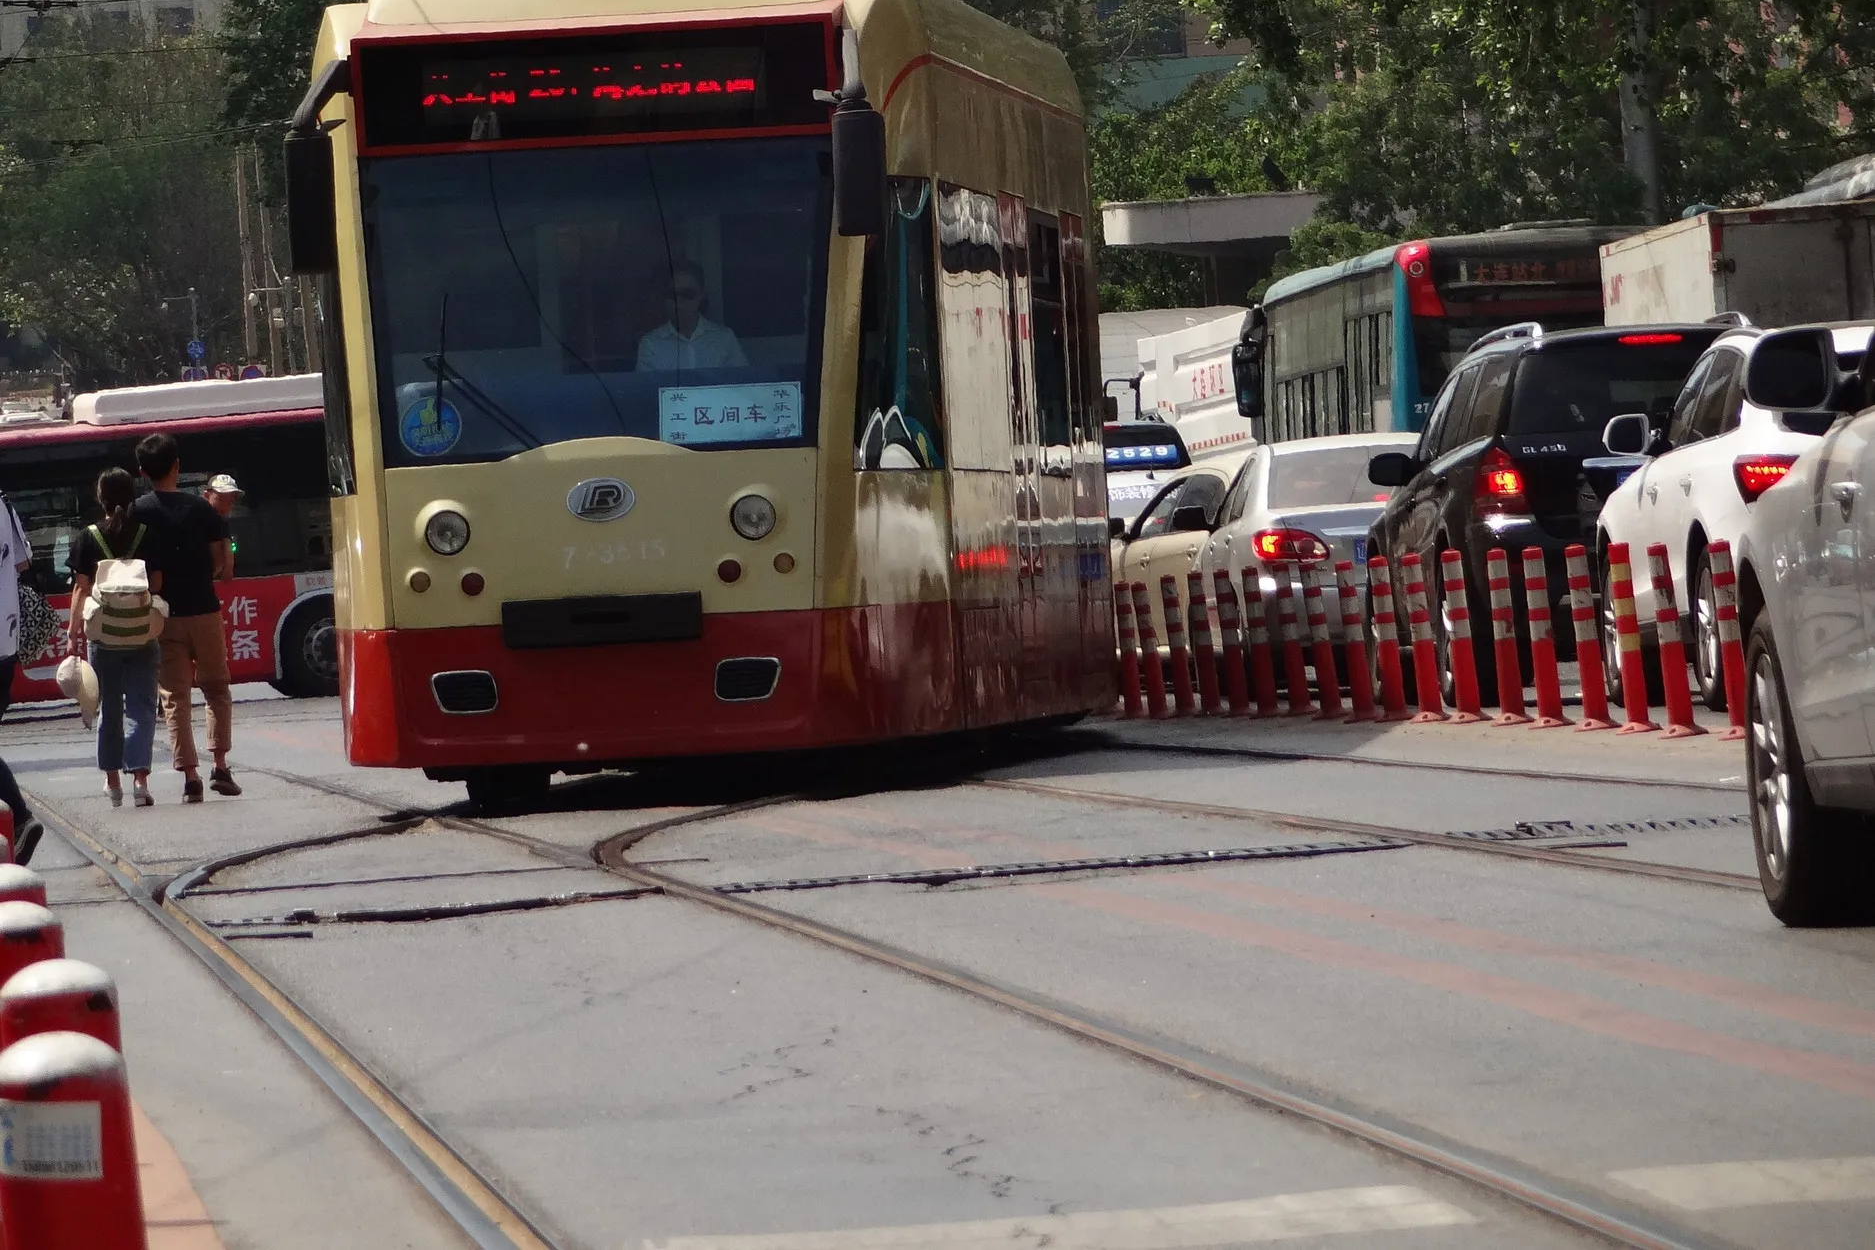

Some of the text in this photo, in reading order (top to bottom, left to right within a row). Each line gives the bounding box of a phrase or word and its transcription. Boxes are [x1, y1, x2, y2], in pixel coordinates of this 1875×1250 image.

[669, 392, 688, 441] 兴工街
[693, 404, 768, 426] 区间车
[1522, 446, 1537, 454] GL
